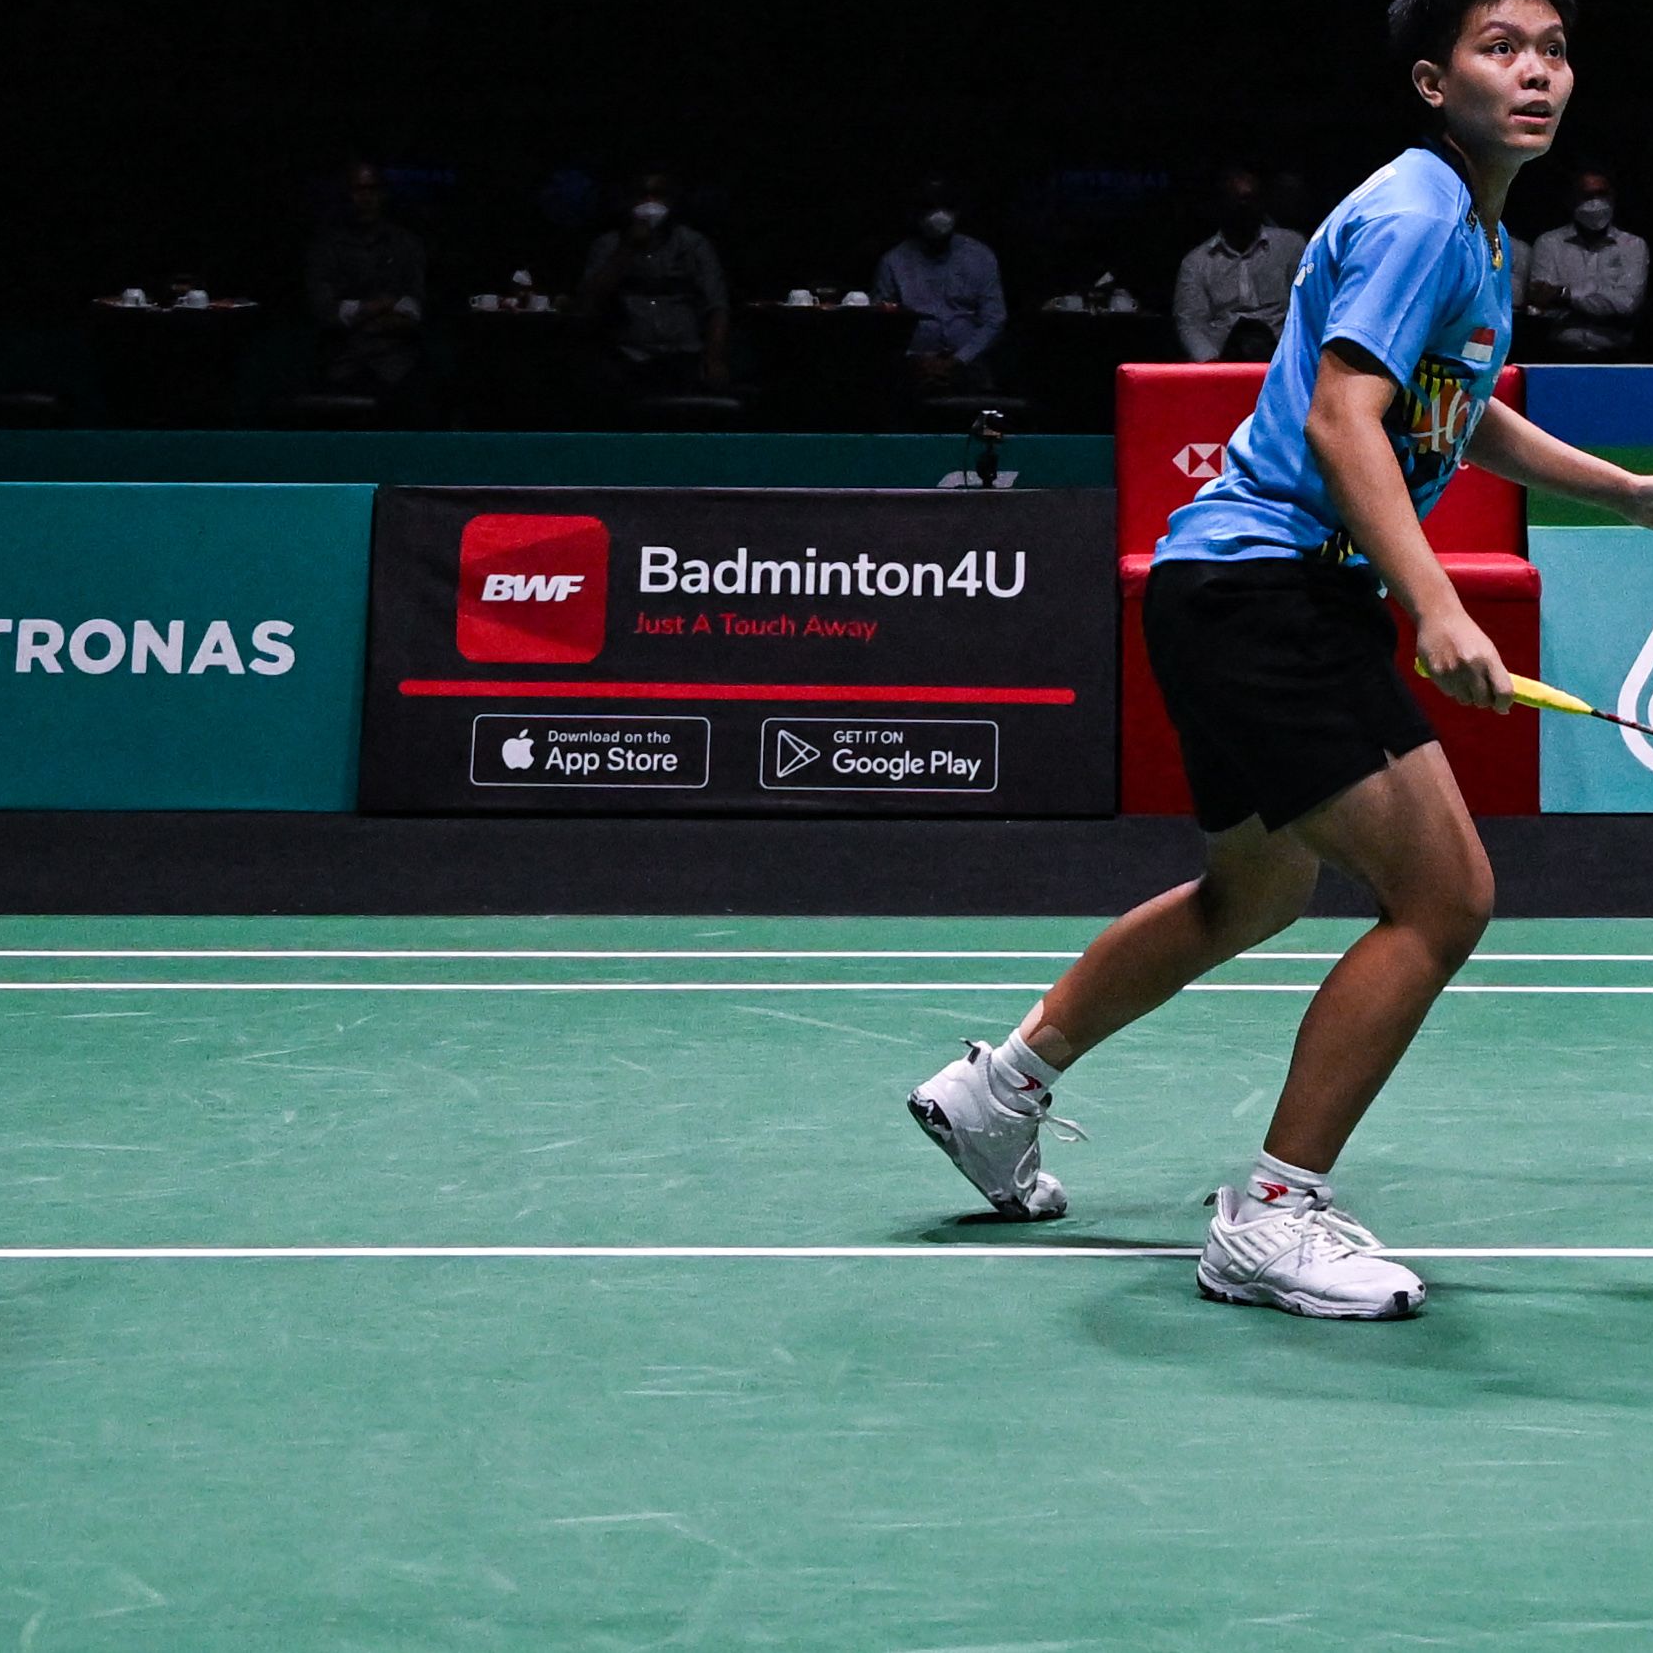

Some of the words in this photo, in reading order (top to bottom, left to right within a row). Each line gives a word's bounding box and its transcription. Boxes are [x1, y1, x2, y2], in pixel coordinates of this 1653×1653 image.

[639, 545, 1026, 599] Badminton4U
[480, 573, 586, 603] BWF
[633, 611, 686, 635] Just
[691, 613, 712, 635] A
[718, 612, 796, 637] Touch
[802, 614, 878, 643] Away
[547, 729, 621, 743] Download
[623, 733, 643, 744] on
[646, 730, 671, 744] the
[833, 730, 862, 744] GET
[865, 730, 878, 744] IT
[880, 730, 904, 745] ON
[544, 746, 601, 776] App
[606, 746, 679, 772] Store
[832, 748, 925, 782] Google
[929, 750, 982, 782] Play
